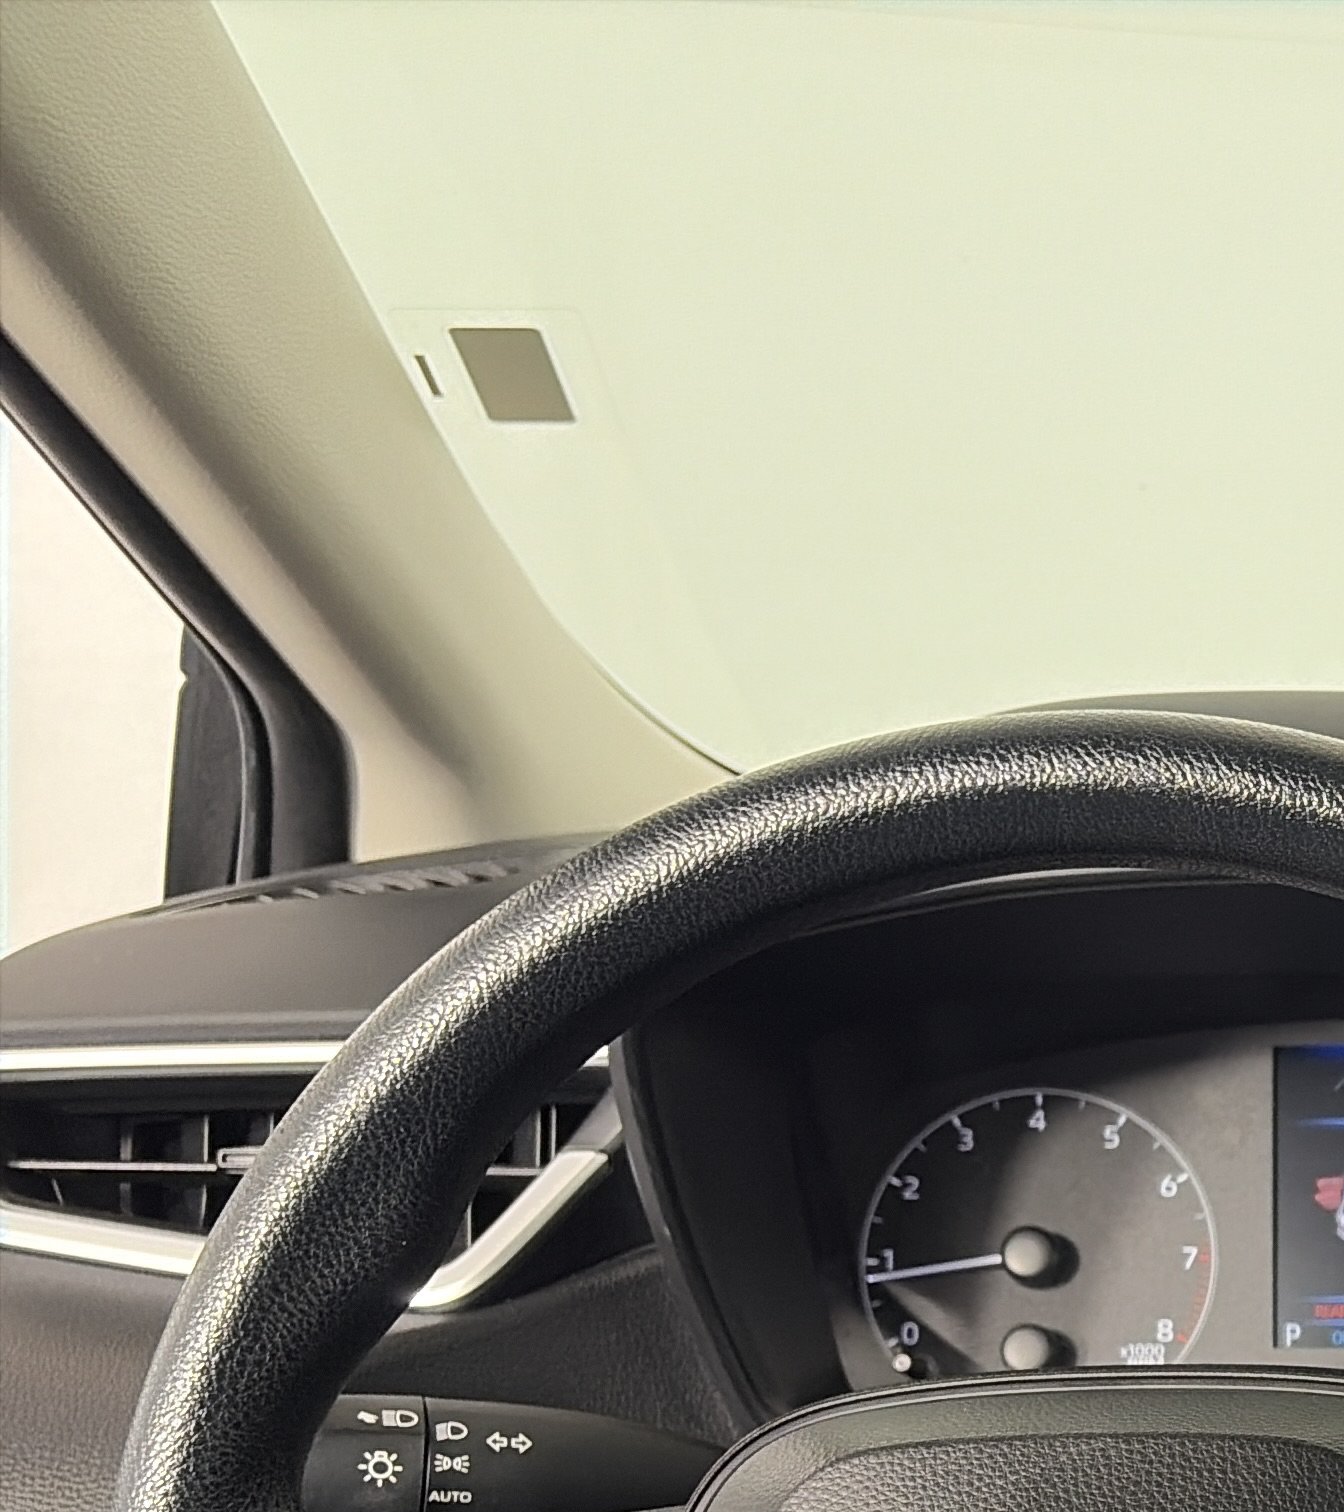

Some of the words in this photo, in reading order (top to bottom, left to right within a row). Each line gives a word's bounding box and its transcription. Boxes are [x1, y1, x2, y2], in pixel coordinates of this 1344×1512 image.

[1027, 1108, 1047, 1132] 4
[956, 1126, 975, 1151] 3
[1103, 1124, 1121, 1150] 5
[902, 1175, 920, 1200] 2
[1160, 1174, 1178, 1198] 6
[882, 1248, 895, 1272] 1
[1181, 1245, 1198, 1271] 7
[901, 1320, 920, 1346] 0
[1156, 1318, 1174, 1343] 8
[1286, 1322, 1302, 1347] P
[428, 1490, 473, 1504] AUTO
